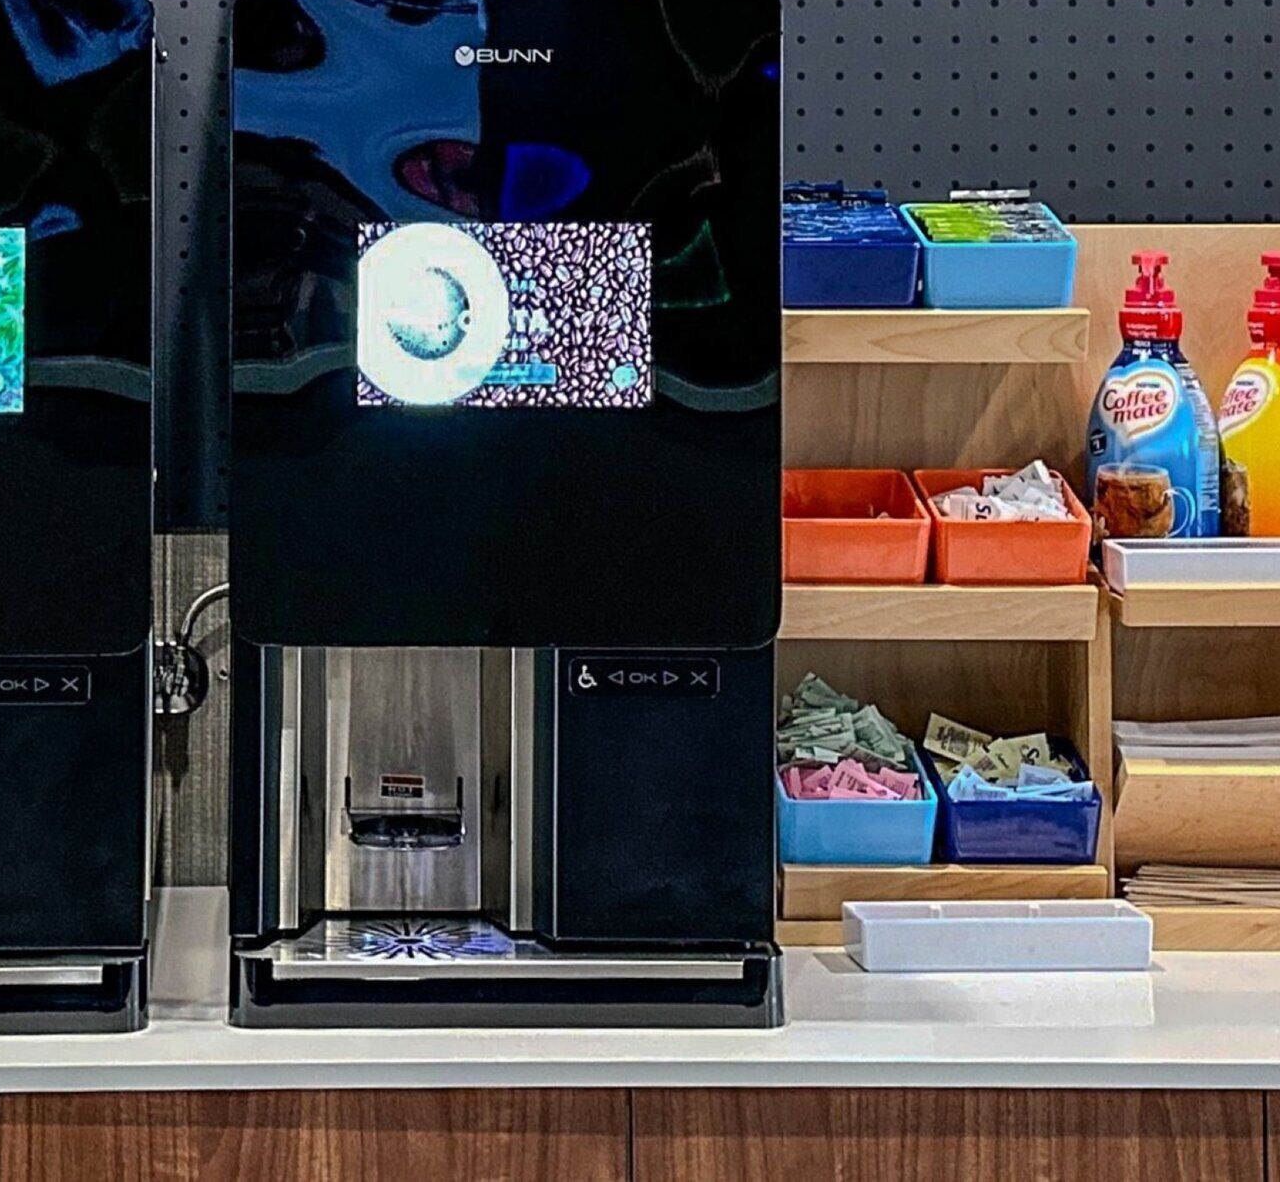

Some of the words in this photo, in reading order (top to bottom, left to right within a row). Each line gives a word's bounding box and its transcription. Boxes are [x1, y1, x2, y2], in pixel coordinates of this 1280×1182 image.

[476, 48, 551, 63] BUNN
[1102, 389, 1167, 412] Coffee
[1113, 402, 1168, 424] mate
[0, 679, 28, 691] OK
[629, 672, 658, 684] OK
